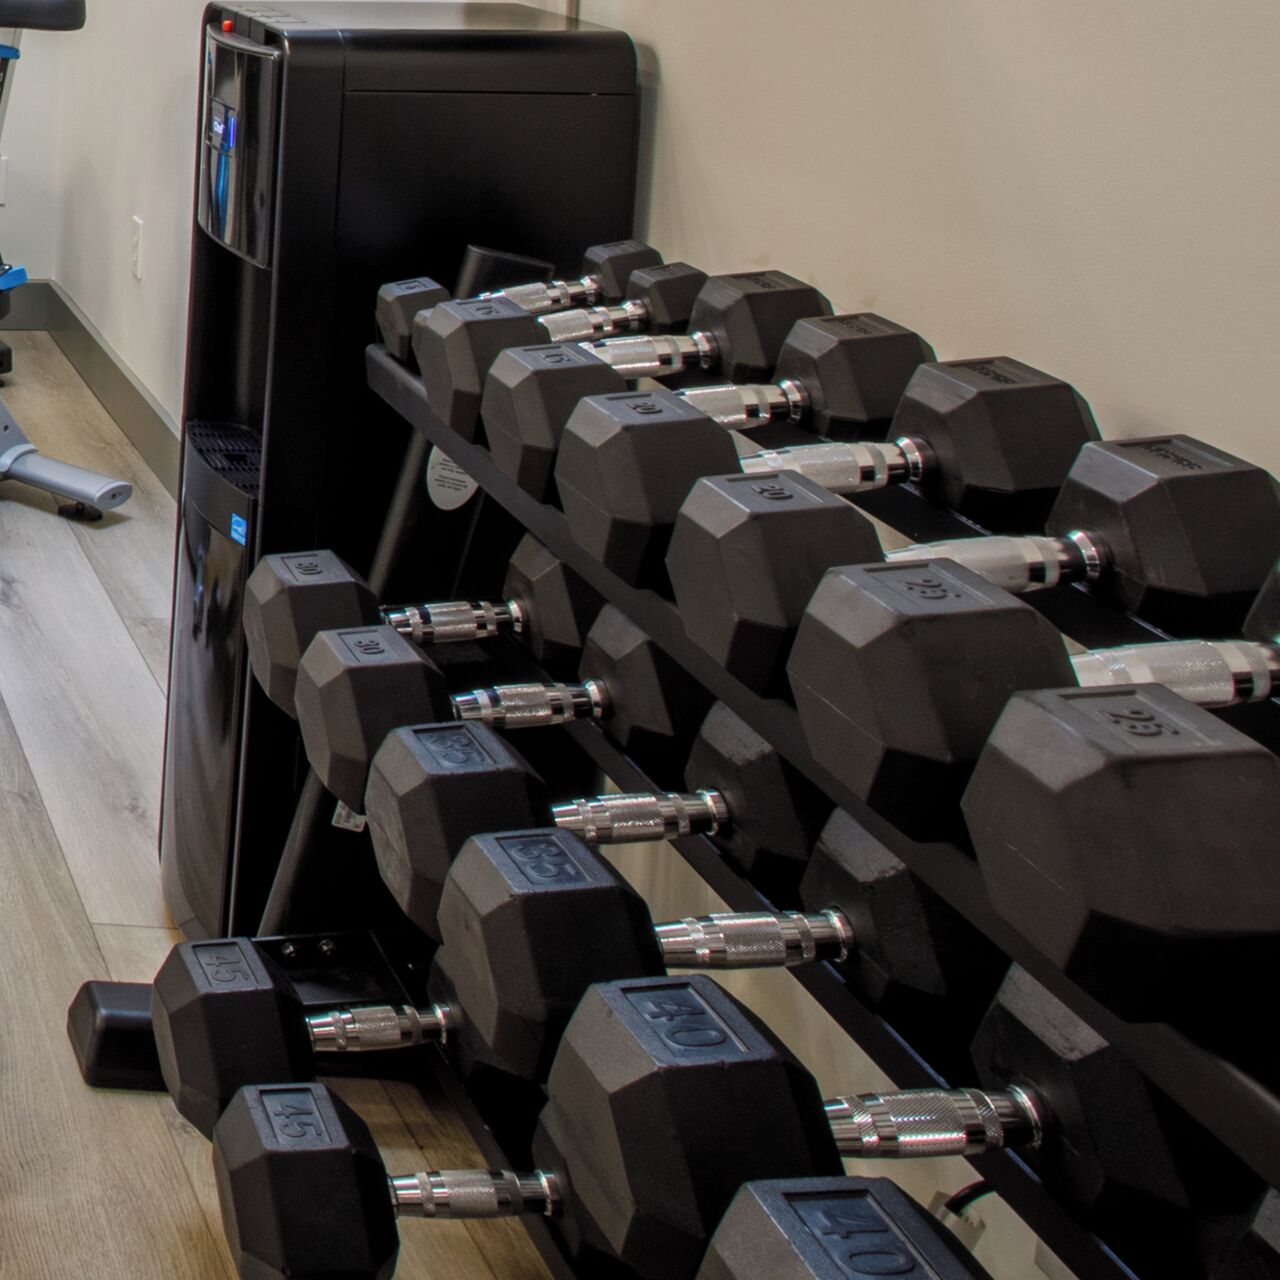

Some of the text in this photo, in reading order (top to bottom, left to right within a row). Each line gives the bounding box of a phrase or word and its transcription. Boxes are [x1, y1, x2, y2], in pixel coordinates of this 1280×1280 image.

[626, 401, 663, 415] 20
[751, 484, 793, 500] 20
[295, 561, 323, 575] 30
[904, 578, 961, 599] 25
[354, 639, 385, 655] 30
[1100, 708, 1180, 736] 25
[428, 734, 485, 767] 35
[510, 843, 577, 880] 35
[205, 954, 249, 982] 45
[644, 1000, 728, 1048] 40
[273, 1103, 322, 1138] 45
[821, 1208, 916, 1276] 40
